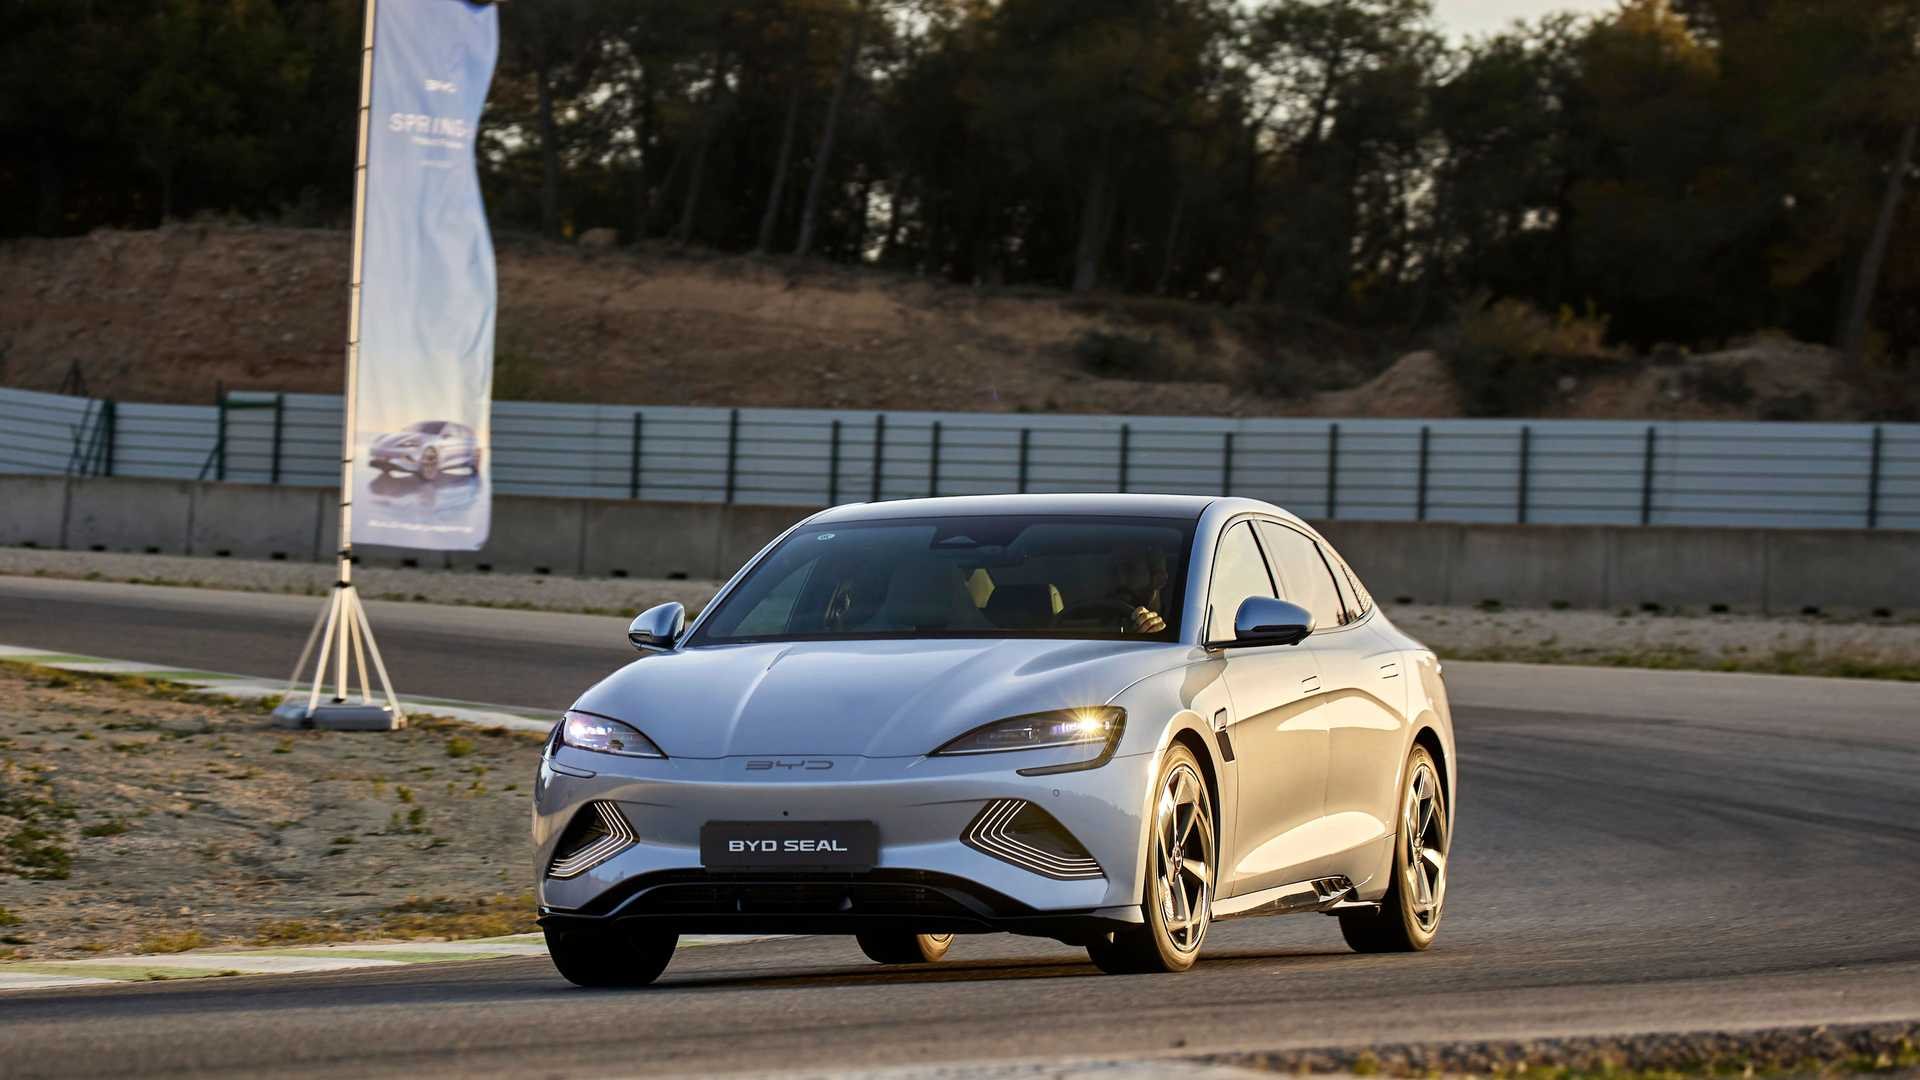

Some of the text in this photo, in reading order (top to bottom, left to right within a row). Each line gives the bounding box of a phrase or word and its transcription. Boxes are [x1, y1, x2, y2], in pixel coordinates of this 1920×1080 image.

[745, 760, 835, 770] BYD
[728, 840, 848, 852] BYD SEAL
